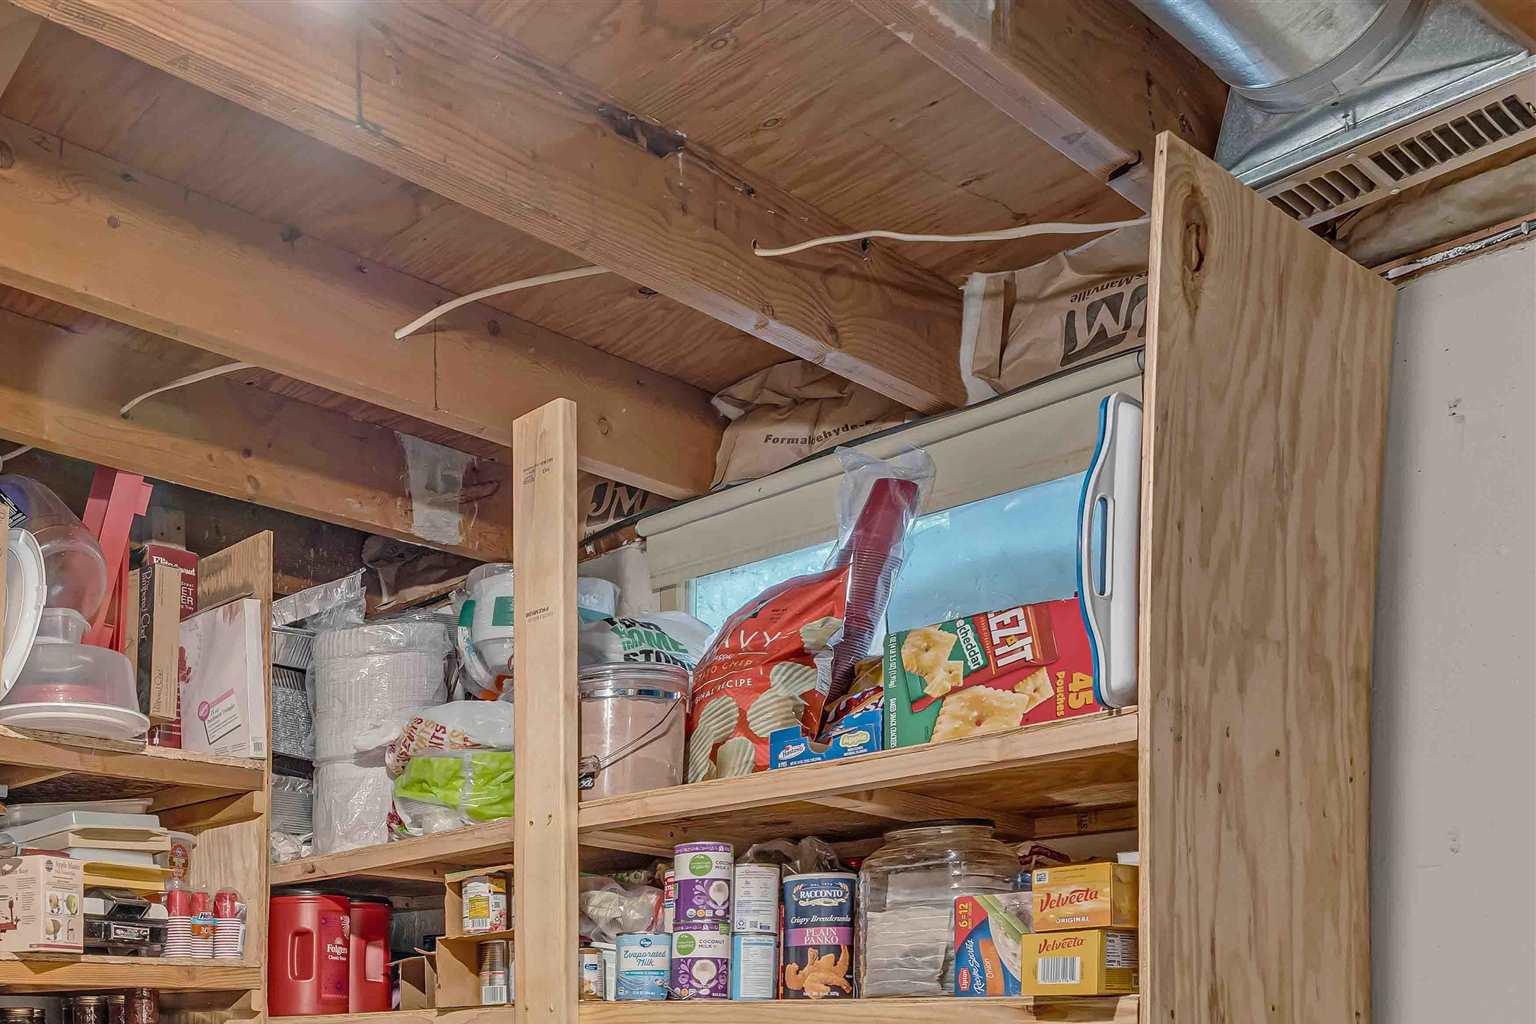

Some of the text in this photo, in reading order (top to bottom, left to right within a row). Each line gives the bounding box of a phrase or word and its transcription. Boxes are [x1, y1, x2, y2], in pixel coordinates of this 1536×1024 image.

[957, 624, 983, 669] cheddar
[1068, 672, 1093, 710] 45
[799, 890, 844, 899] RACCONTO
[1039, 887, 1099, 913] Velveeta
[1038, 937, 1084, 954] Velveeta
[636, 957, 655, 968] Milk
